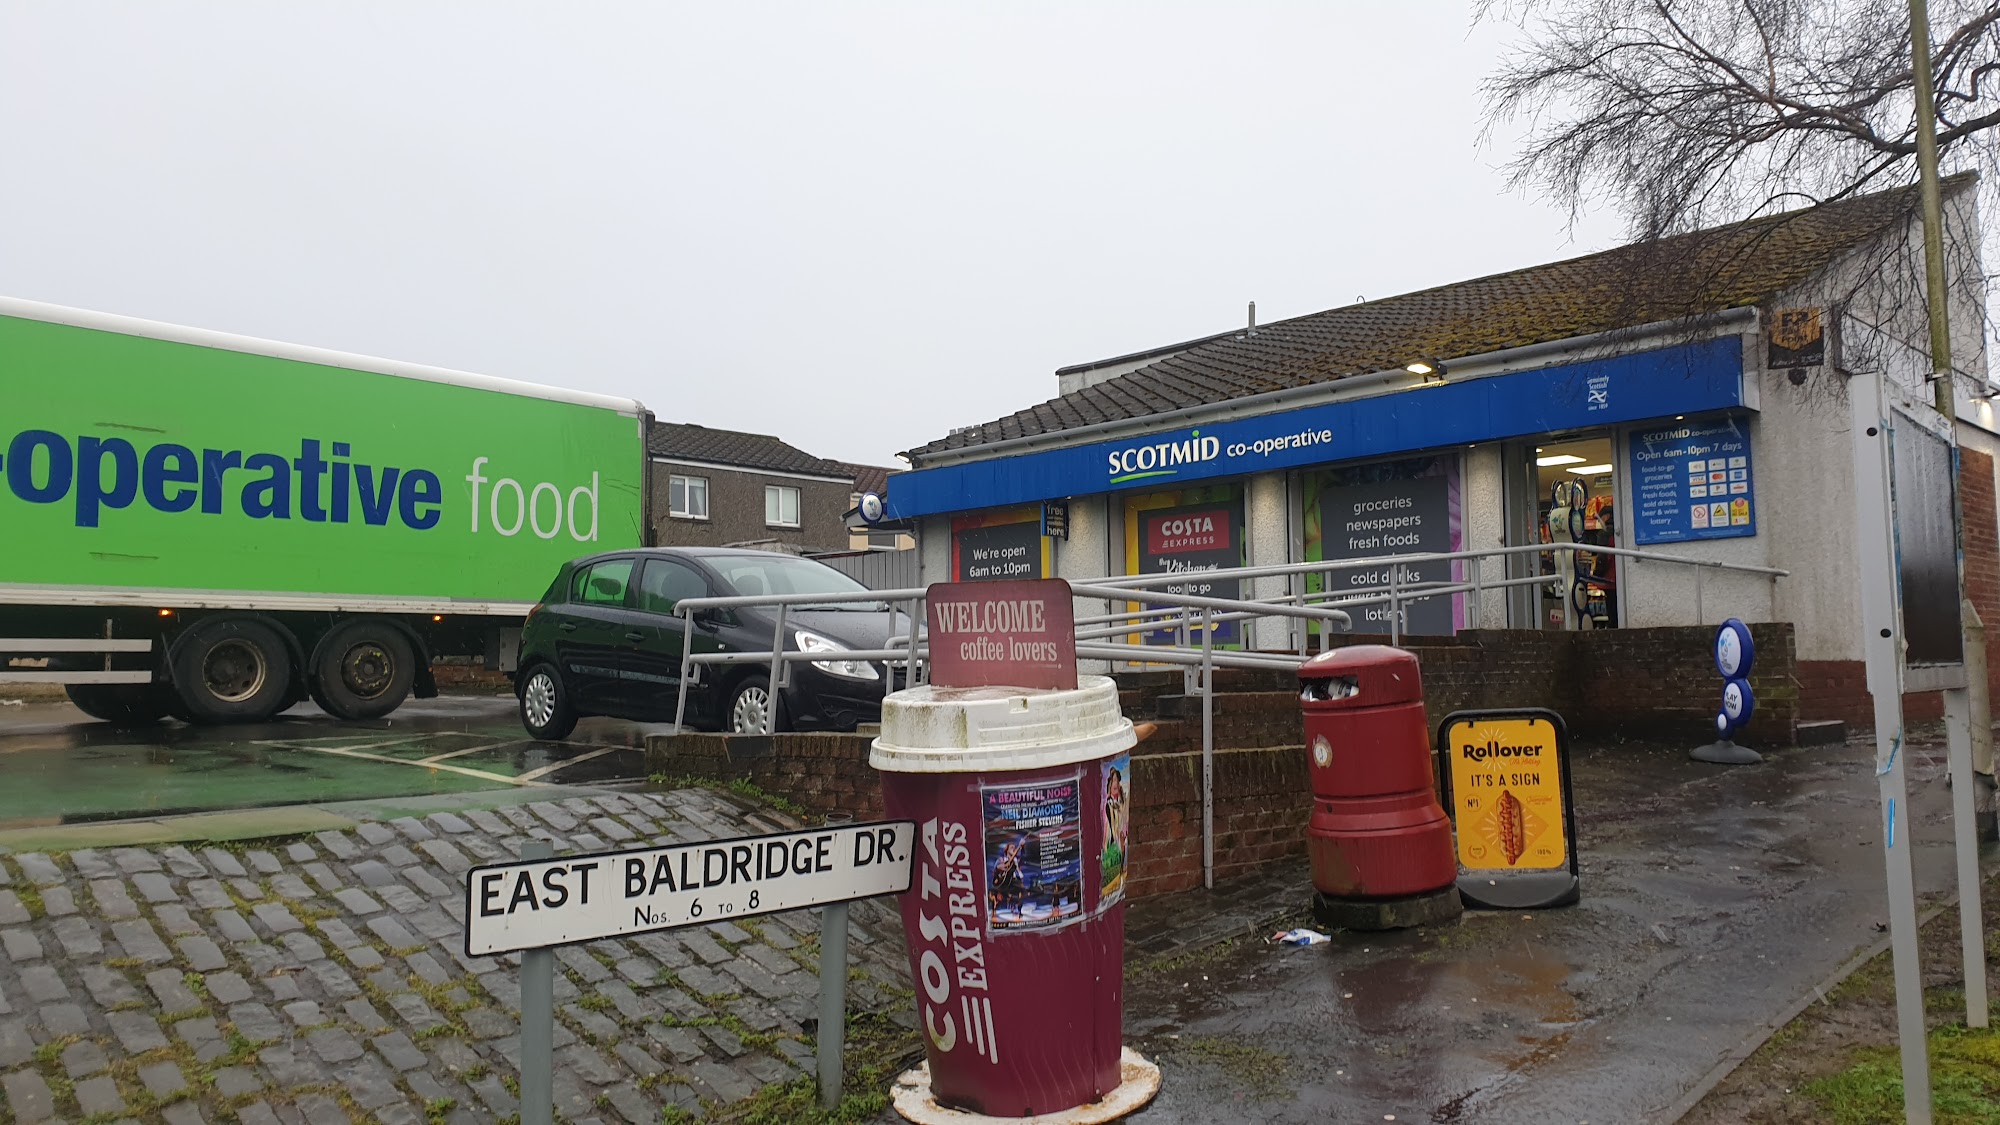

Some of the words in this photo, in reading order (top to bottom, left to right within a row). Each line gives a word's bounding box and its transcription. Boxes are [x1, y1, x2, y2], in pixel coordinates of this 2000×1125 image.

[1642, 428, 1691, 443] SCOTMID
[1108, 430, 1220, 474] SCOTMID
[1227, 429, 1332, 457] co-operative
[1637, 450, 1661, 461] Open
[1713, 443, 1719, 452] 7
[1722, 442, 1742, 452] days
[0, 429, 442, 530] operative
[465, 456, 599, 542] food
[1641, 482, 1677, 491] newspapers
[1644, 474, 1673, 483] groceries
[1659, 490, 1676, 498] foods
[1047, 504, 1064, 516] free
[1353, 497, 1412, 516] groceries
[1657, 499, 1676, 507] drinks
[1642, 509, 1656, 517] beer
[1161, 517, 1214, 537] COSTA
[1346, 515, 1421, 532] newspapers
[1650, 517, 1671, 526] lottery
[1047, 526, 1065, 537] here
[1170, 536, 1214, 548] EXPRESS
[1349, 535, 1380, 550] fresh
[1383, 532, 1420, 547] foods
[973, 548, 999, 561] We're
[1001, 546, 1026, 560] open
[969, 566, 989, 578] 6am
[991, 565, 1001, 576] to
[1003, 562, 1031, 576] 10pm
[1166, 559, 1206, 574] Kitchen
[1351, 571, 1378, 585] cold
[1381, 569, 1420, 583] dnks
[1167, 584, 1182, 594] foo
[1189, 583, 1198, 593] to
[1199, 583, 1212, 595] go
[935, 600, 1045, 633] WELCOME
[960, 636, 1004, 661] coffee
[1009, 637, 1058, 661] lovers
[1463, 741, 1543, 762] Rollover
[1471, 774, 1493, 787] IT'S
[1498, 774, 1506, 787] A
[1511, 773, 1540, 786] SIGN
[989, 794, 997, 804] A
[998, 790, 1046, 804] BEAUTIFUL
[1046, 786, 1072, 799] NOISE
[1001, 807, 1021, 820] NEIL
[1022, 803, 1064, 818] DIAMOND
[1016, 818, 1037, 830] FISHER
[1038, 815, 1064, 826] STEVENS
[480, 862, 598, 917] EAST
[625, 834, 833, 898] BALDRIDGE
[854, 828, 905, 868] DR.
[689, 897, 703, 918] 6
[748, 890, 760, 910] 8
[942, 821, 988, 991] EXPRESS
[920, 817, 956, 1052] COSTA
